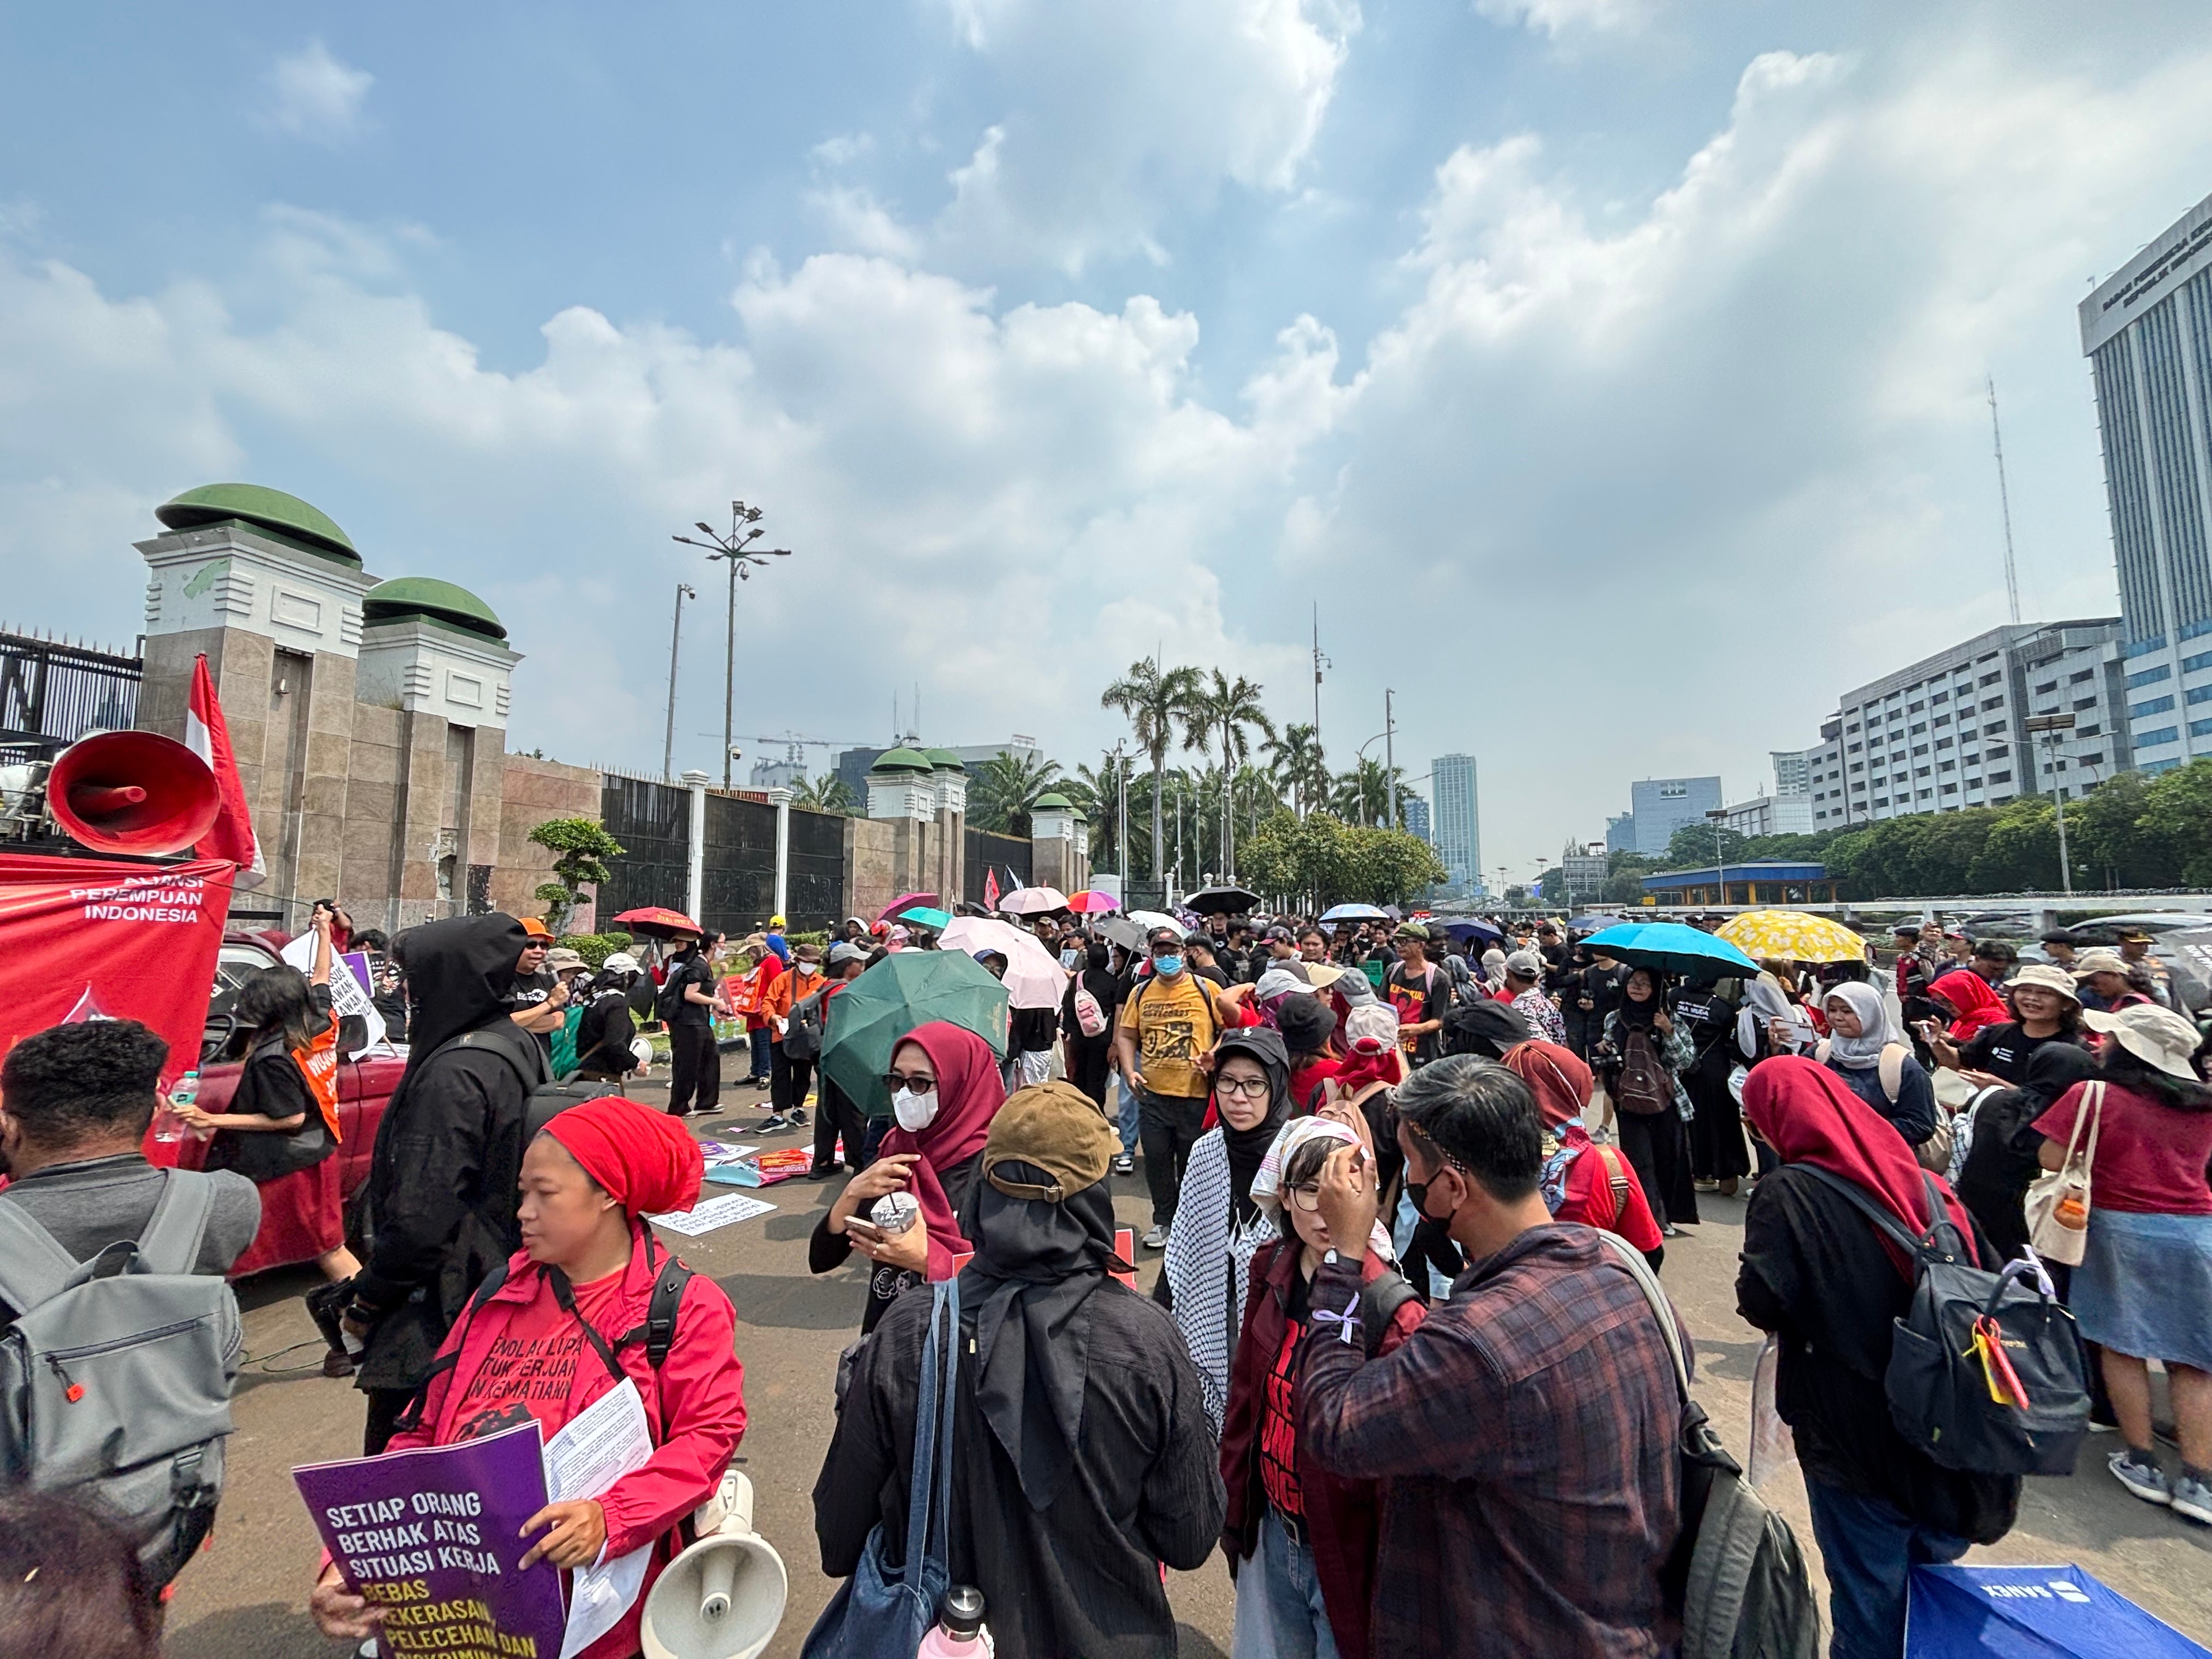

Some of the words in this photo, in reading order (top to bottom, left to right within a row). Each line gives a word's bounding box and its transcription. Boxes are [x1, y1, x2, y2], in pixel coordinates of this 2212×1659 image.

[70, 888, 202, 906] PEREMPUAN
[85, 905, 198, 923] INDONESIA
[327, 1498, 405, 1528] SETIAP
[411, 1492, 482, 1517] ORANG
[337, 1521, 429, 1554] BERHAK
[433, 1519, 481, 1546] ATAS
[349, 1550, 435, 1578] SITUASI
[438, 1546, 501, 1575] KERJA
[1979, 1585, 2053, 1598] SANEX
[384, 1624, 499, 1650] PELECEHAN
[498, 1631, 537, 1659] DAN
